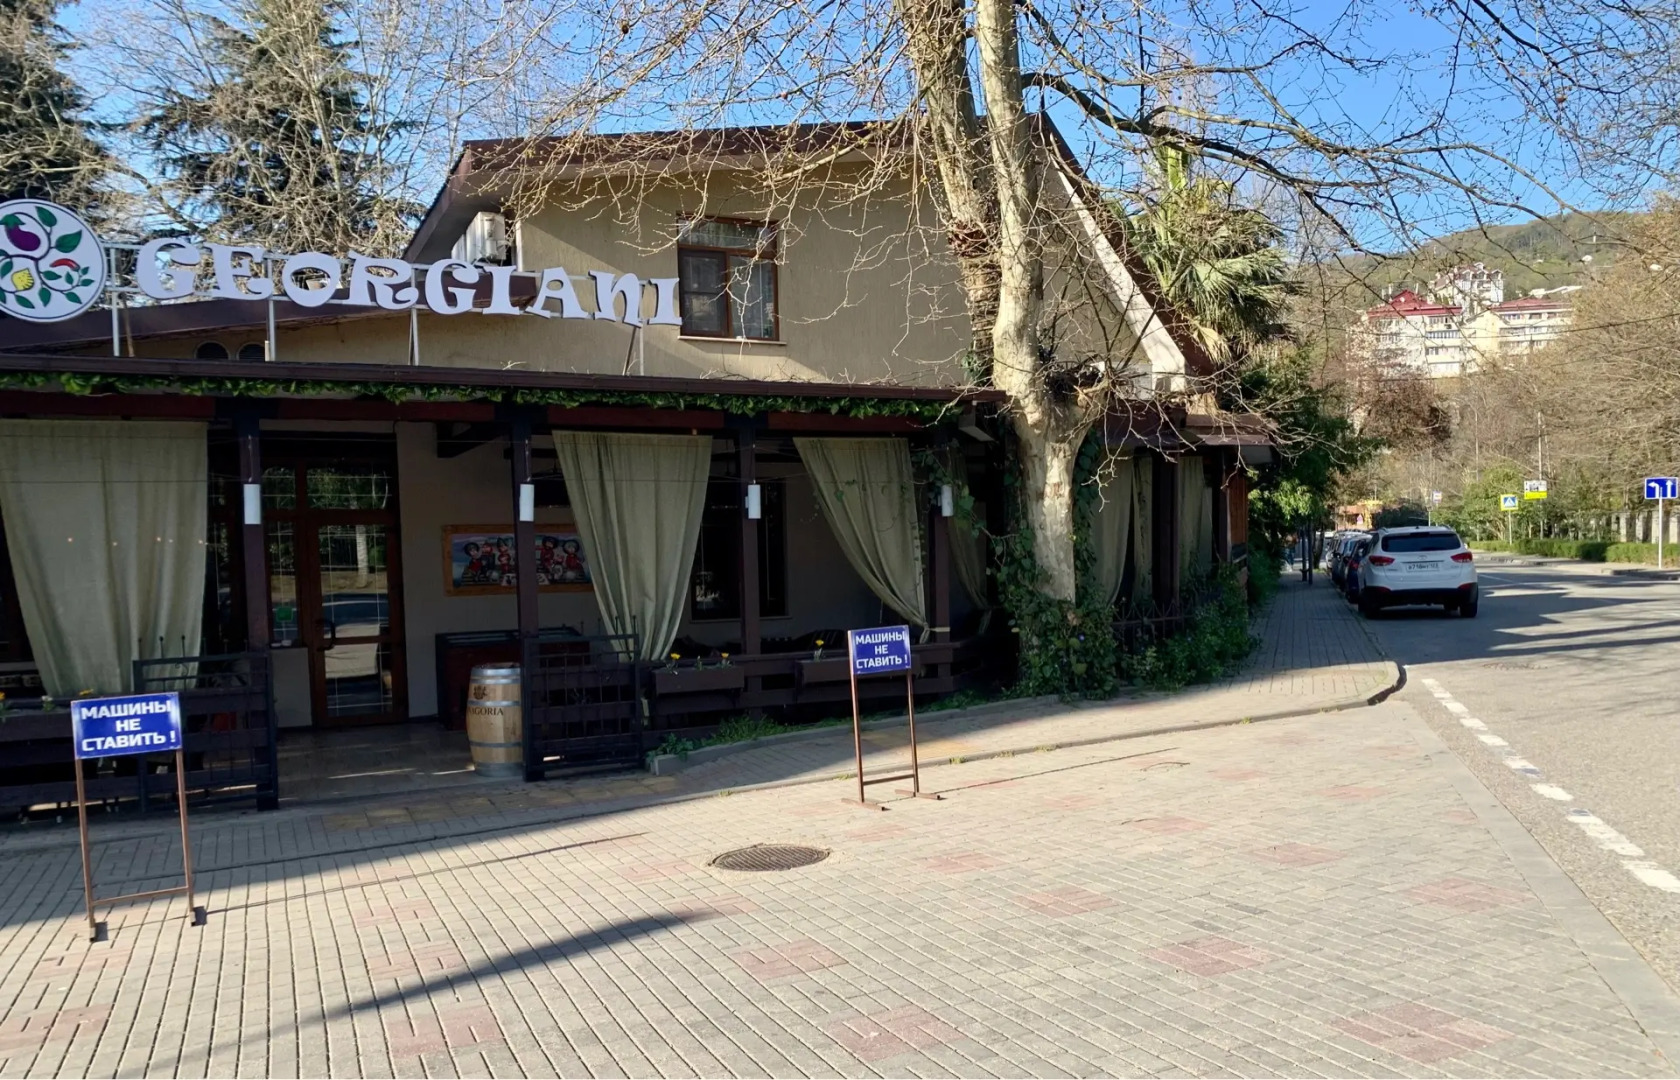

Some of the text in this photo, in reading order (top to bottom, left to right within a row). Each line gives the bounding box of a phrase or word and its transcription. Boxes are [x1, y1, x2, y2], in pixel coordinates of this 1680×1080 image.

[136, 237, 682, 327] GEORGIANI
[855, 631, 905, 645] МАШИНЫ
[874, 644, 889, 655] НЕ
[81, 700, 172, 720] МАШИНЫ
[115, 718, 142, 732] НЕ
